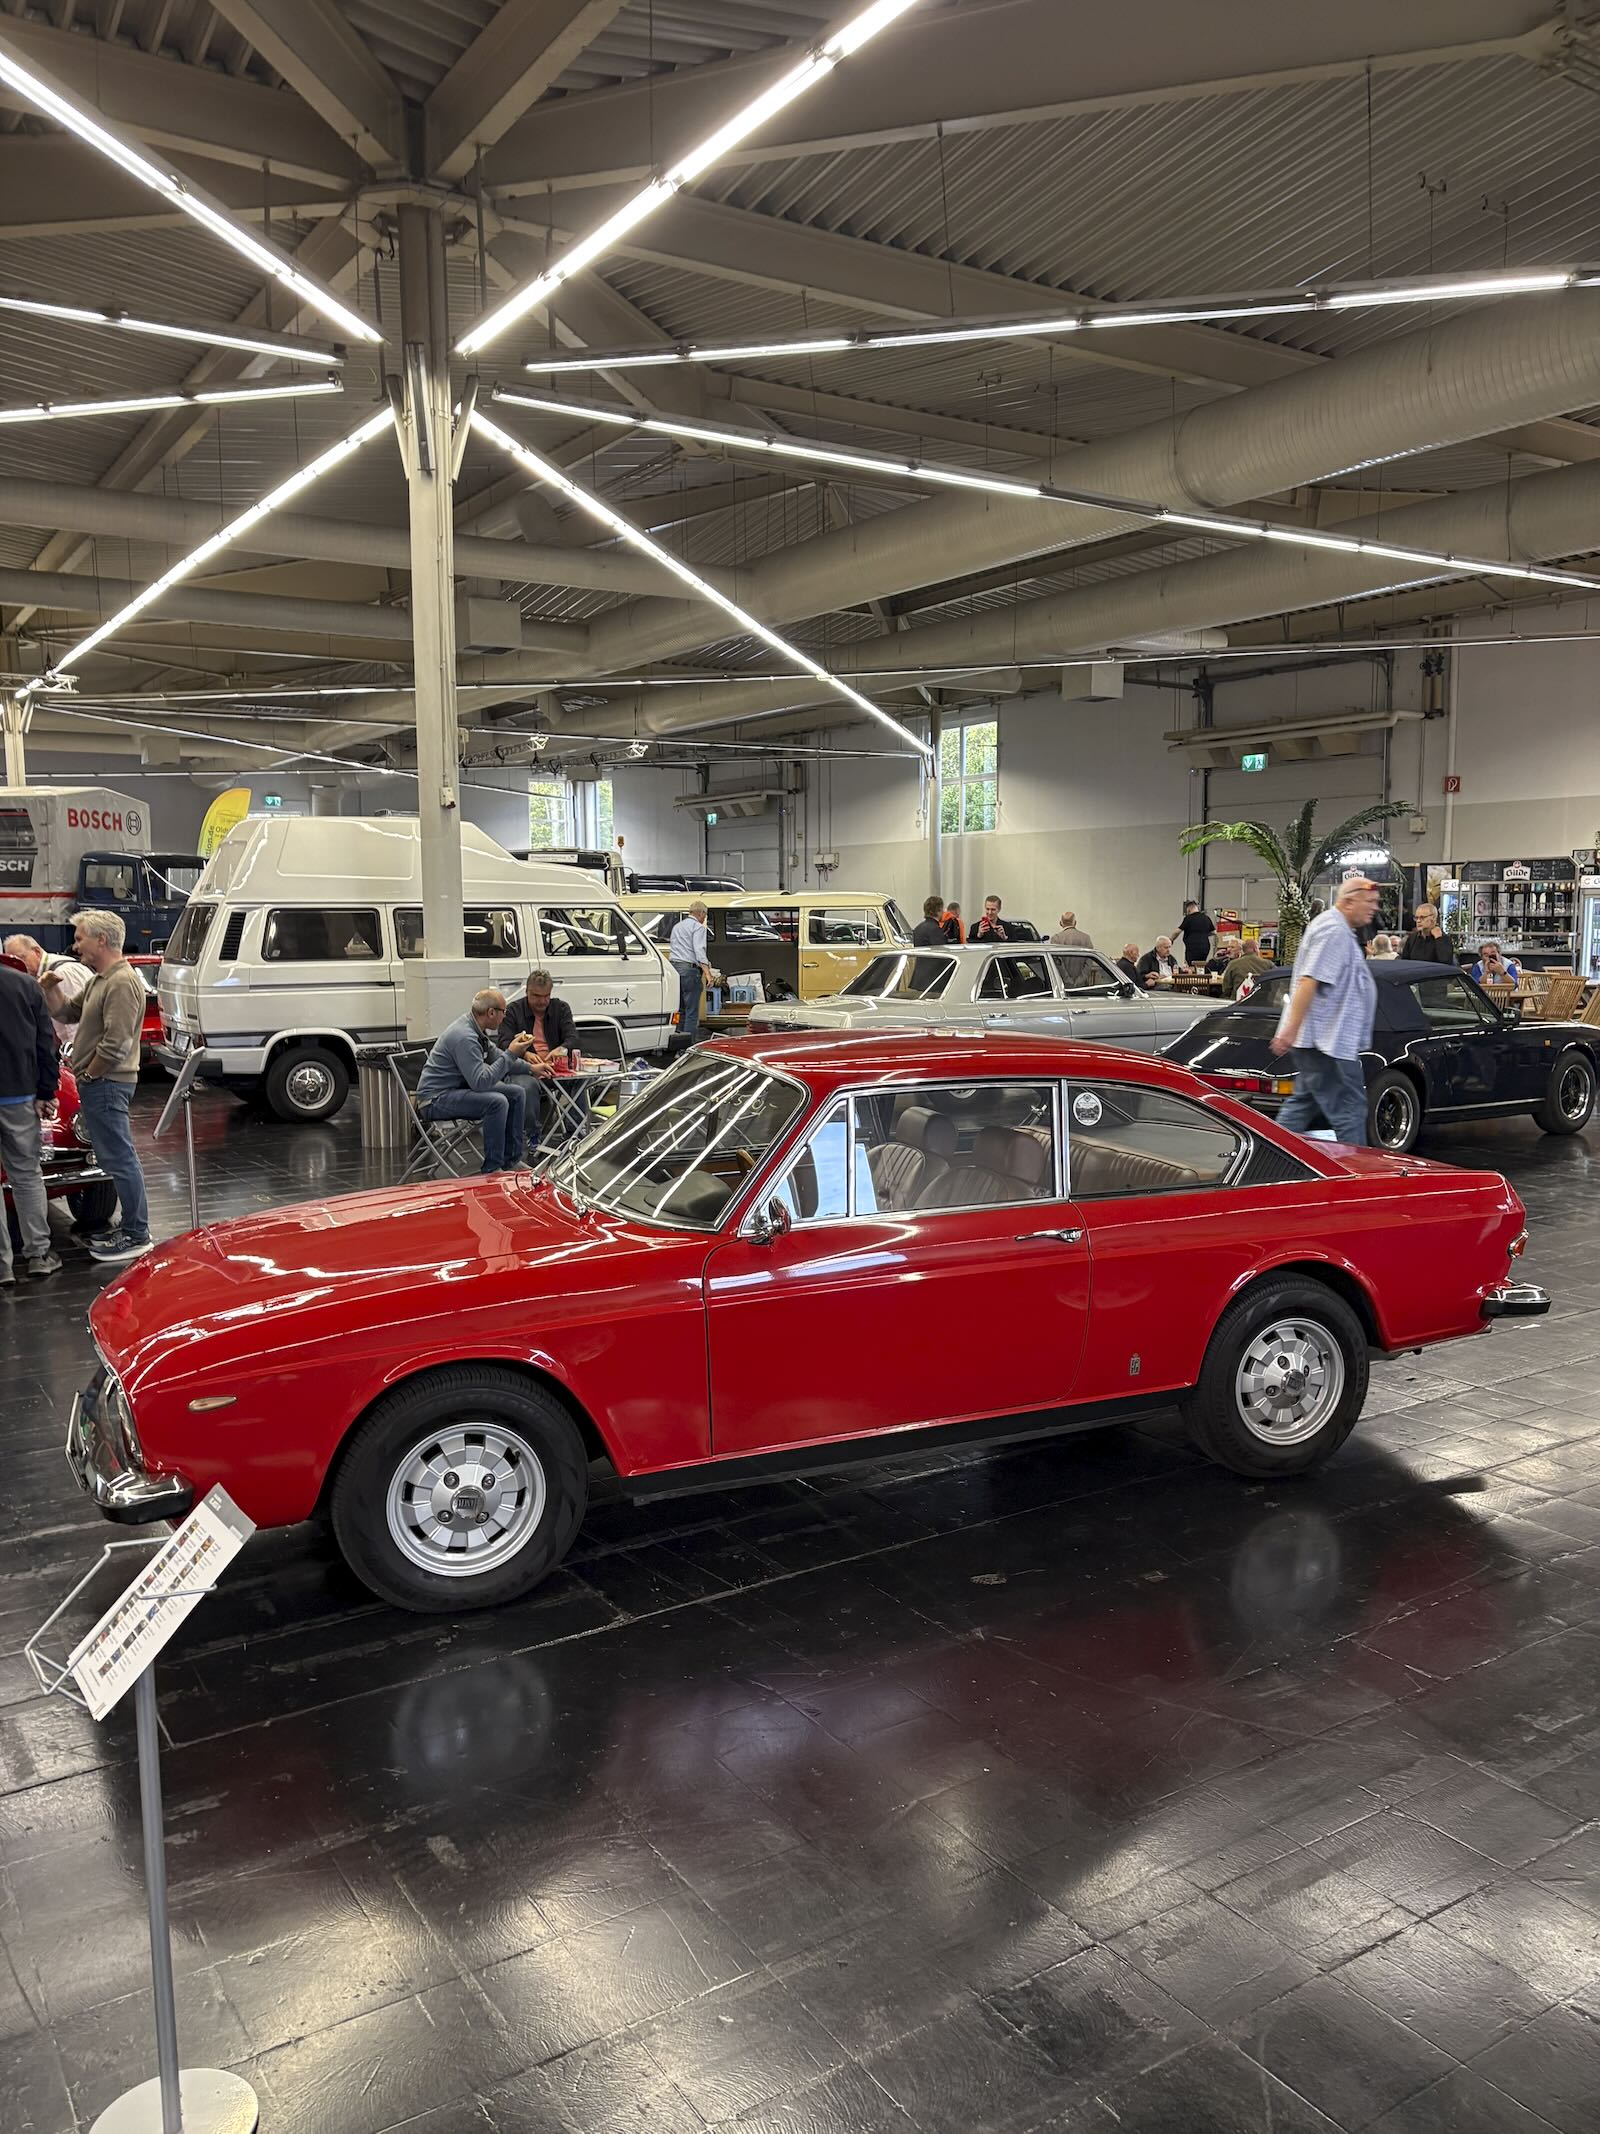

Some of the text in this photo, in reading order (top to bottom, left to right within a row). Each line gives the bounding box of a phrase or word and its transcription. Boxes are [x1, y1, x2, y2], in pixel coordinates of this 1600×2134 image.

[67, 807, 122, 831] BOSCH
[1506, 869, 1528, 877] Gilde
[593, 997, 620, 1005] JOKER
